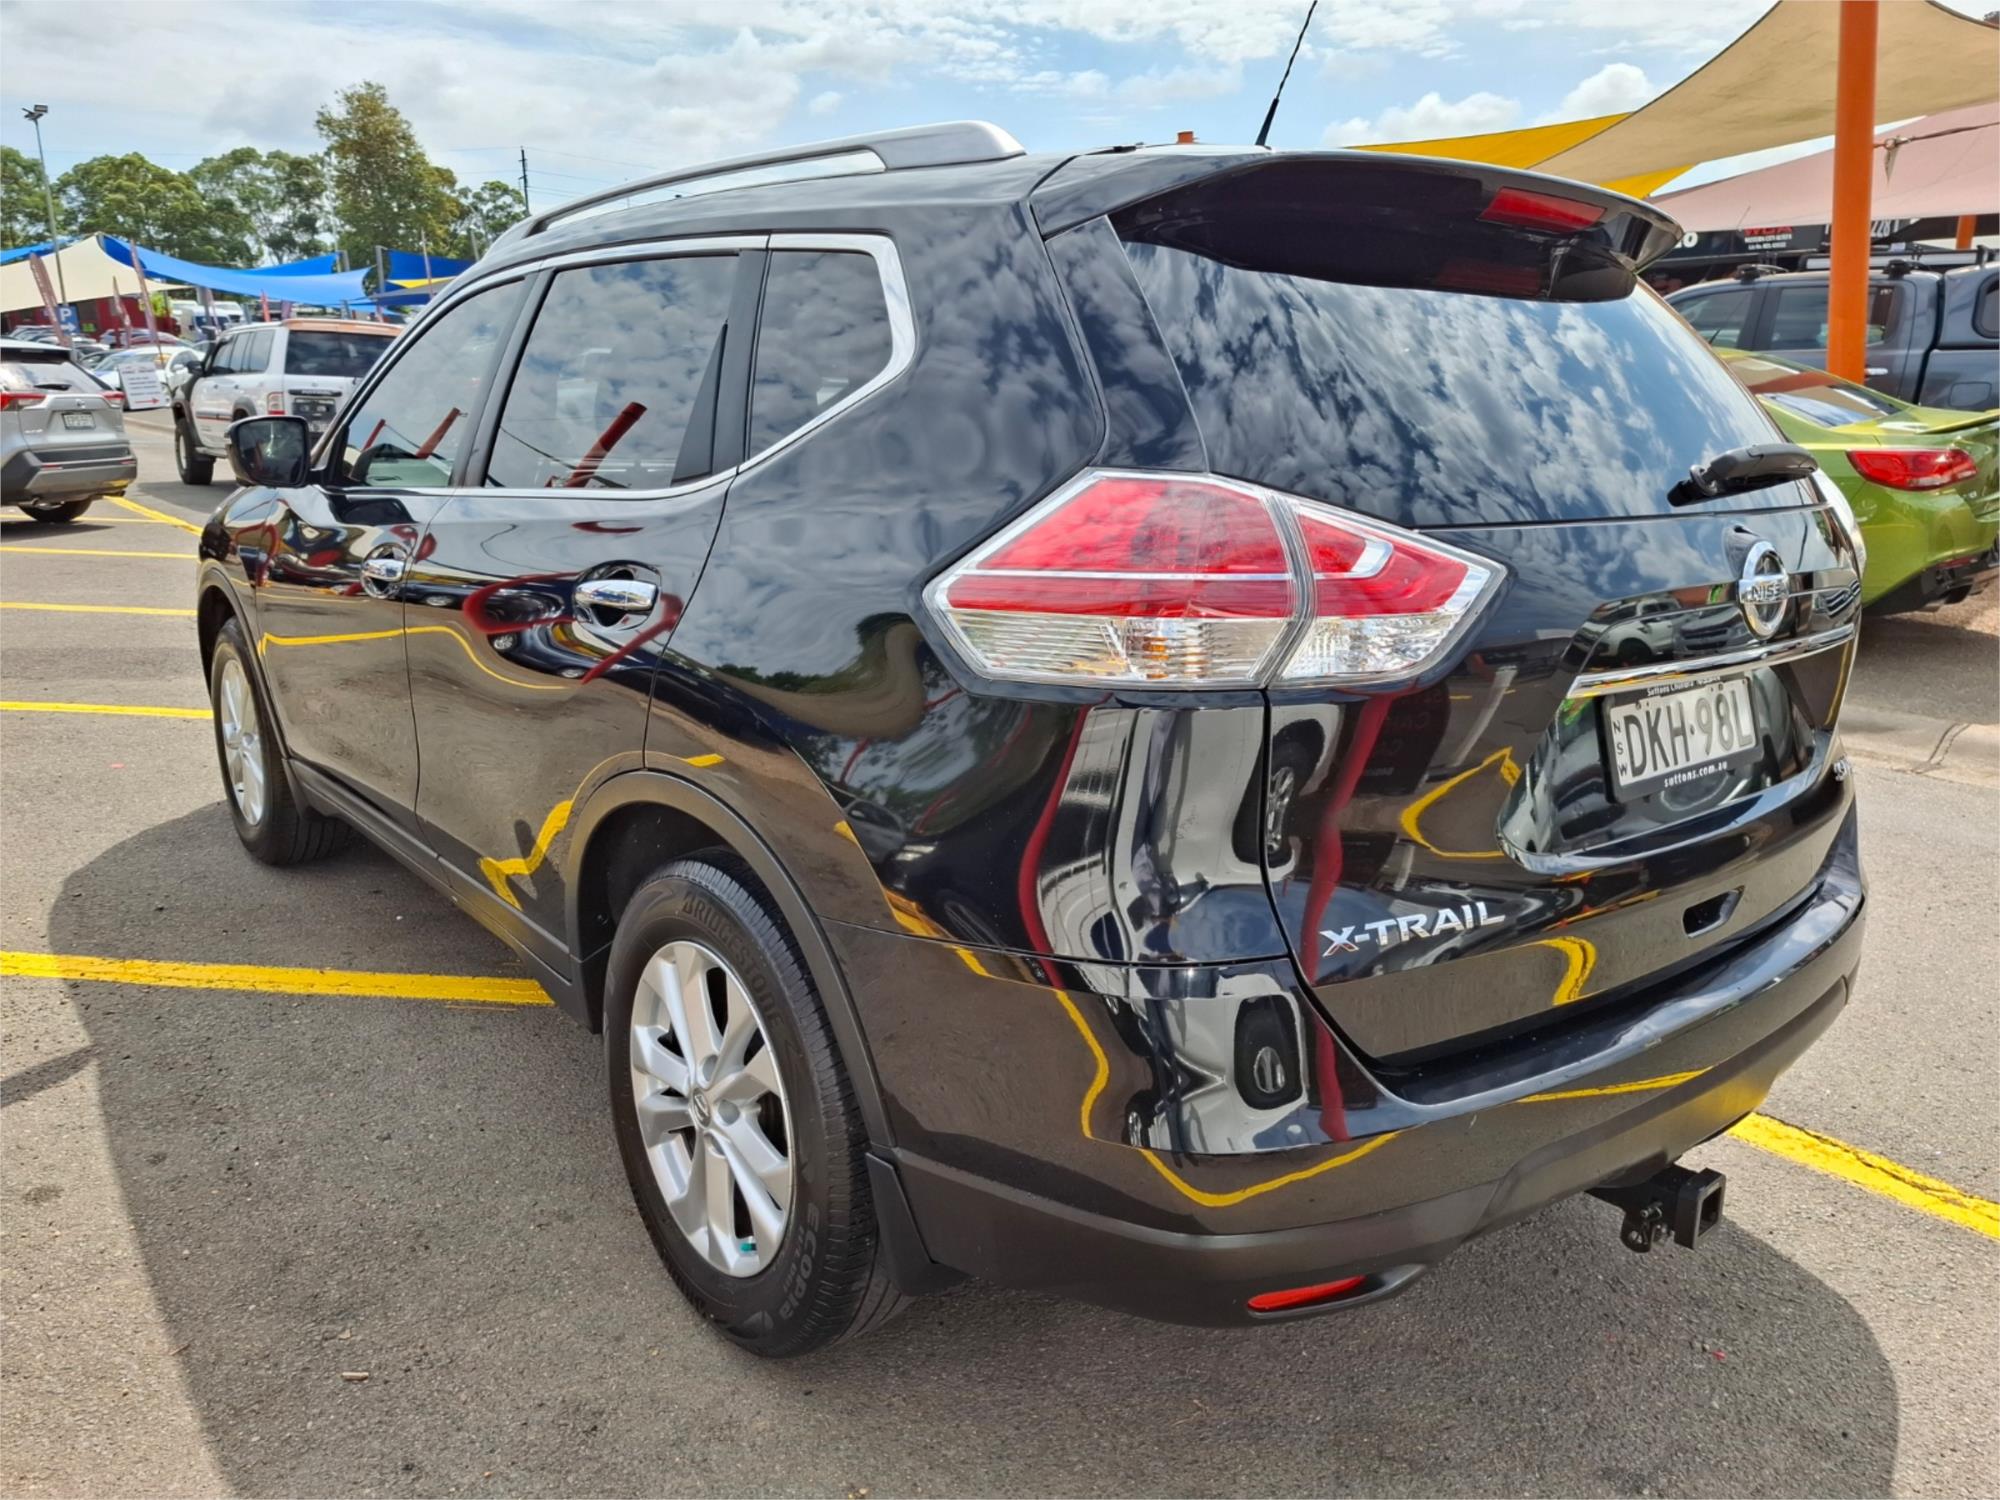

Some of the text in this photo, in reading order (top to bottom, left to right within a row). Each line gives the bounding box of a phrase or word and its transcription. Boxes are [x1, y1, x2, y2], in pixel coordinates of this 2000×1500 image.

[60, 307, 72, 321] P
[1663, 761, 1728, 788] suttons.com.au
[1319, 901, 1506, 958] X-TRAIL
[682, 891, 785, 1028] BRIDGESTONE
